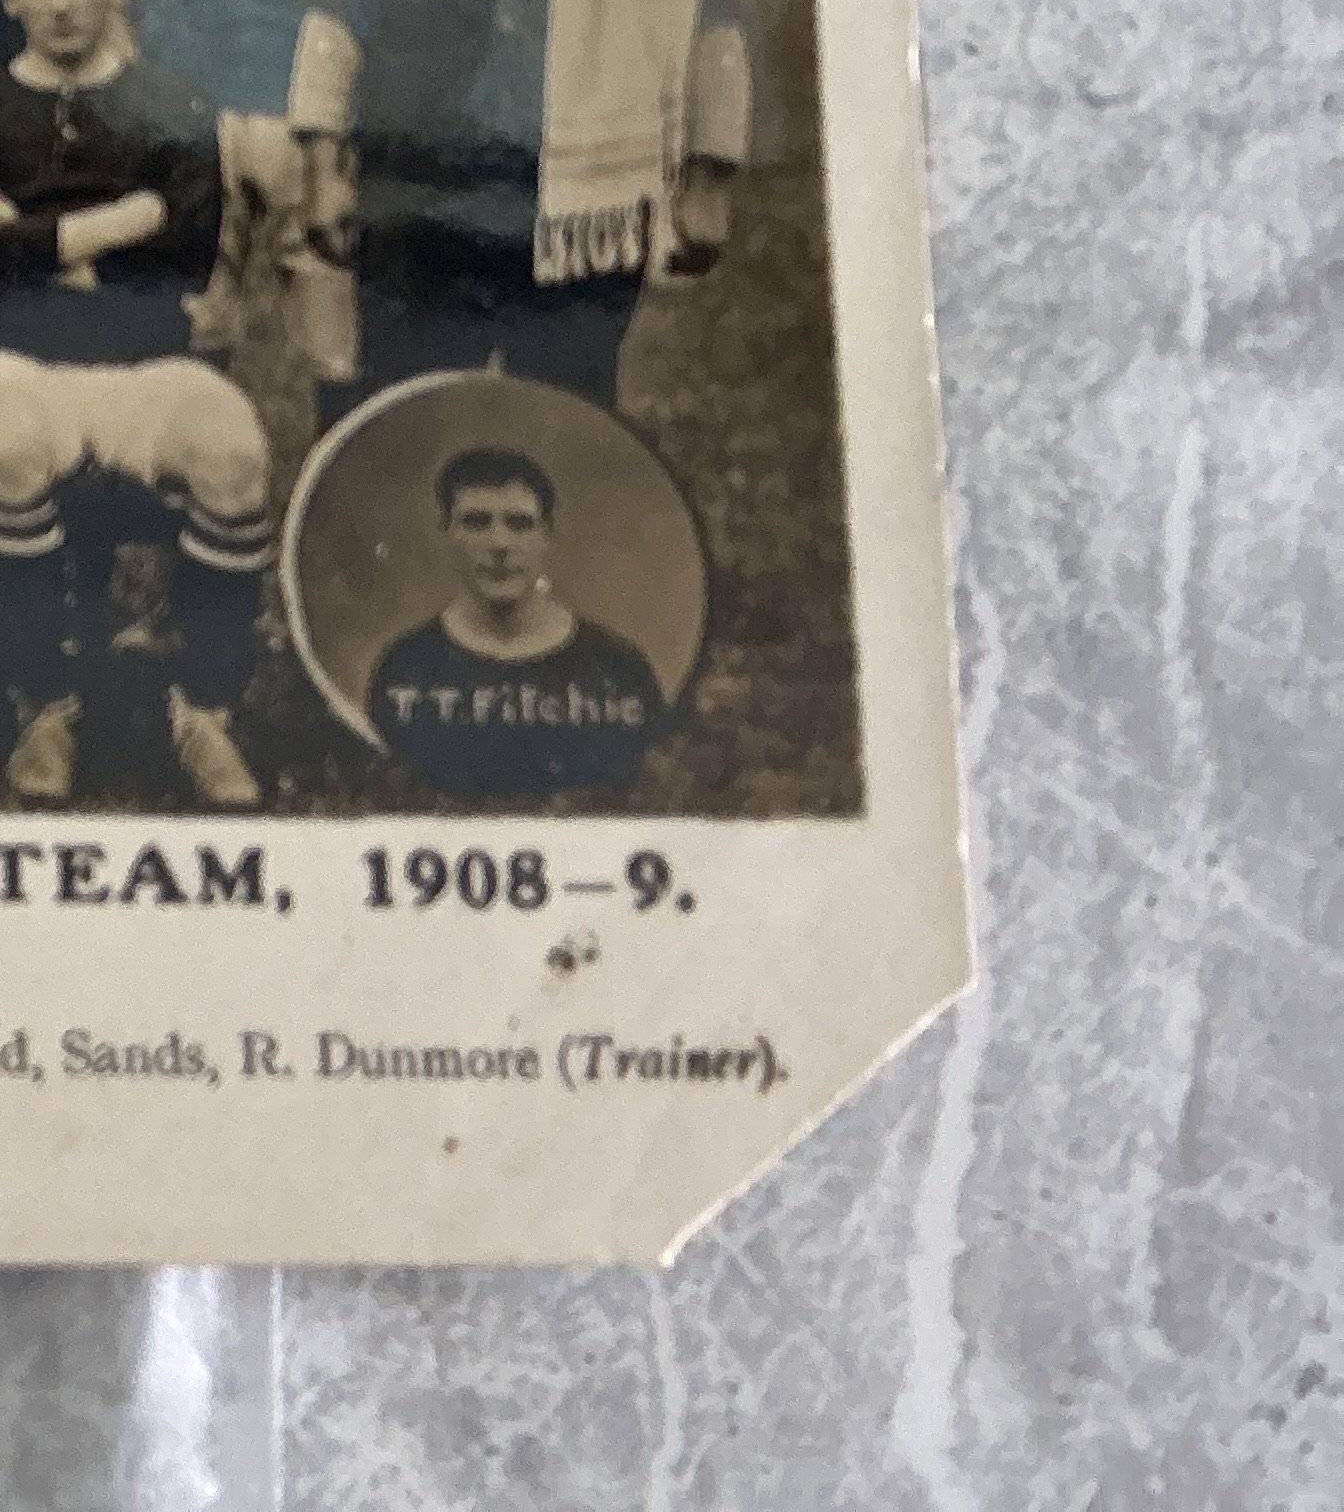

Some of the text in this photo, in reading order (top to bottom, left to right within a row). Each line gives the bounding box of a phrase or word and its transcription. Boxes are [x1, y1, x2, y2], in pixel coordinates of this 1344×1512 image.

[61, 1028, 221, 1085] Sands,
[238, 1031, 295, 1080] R.
[315, 1031, 542, 1083] Dunmore
[556, 1031, 791, 1095] (Trainer).
